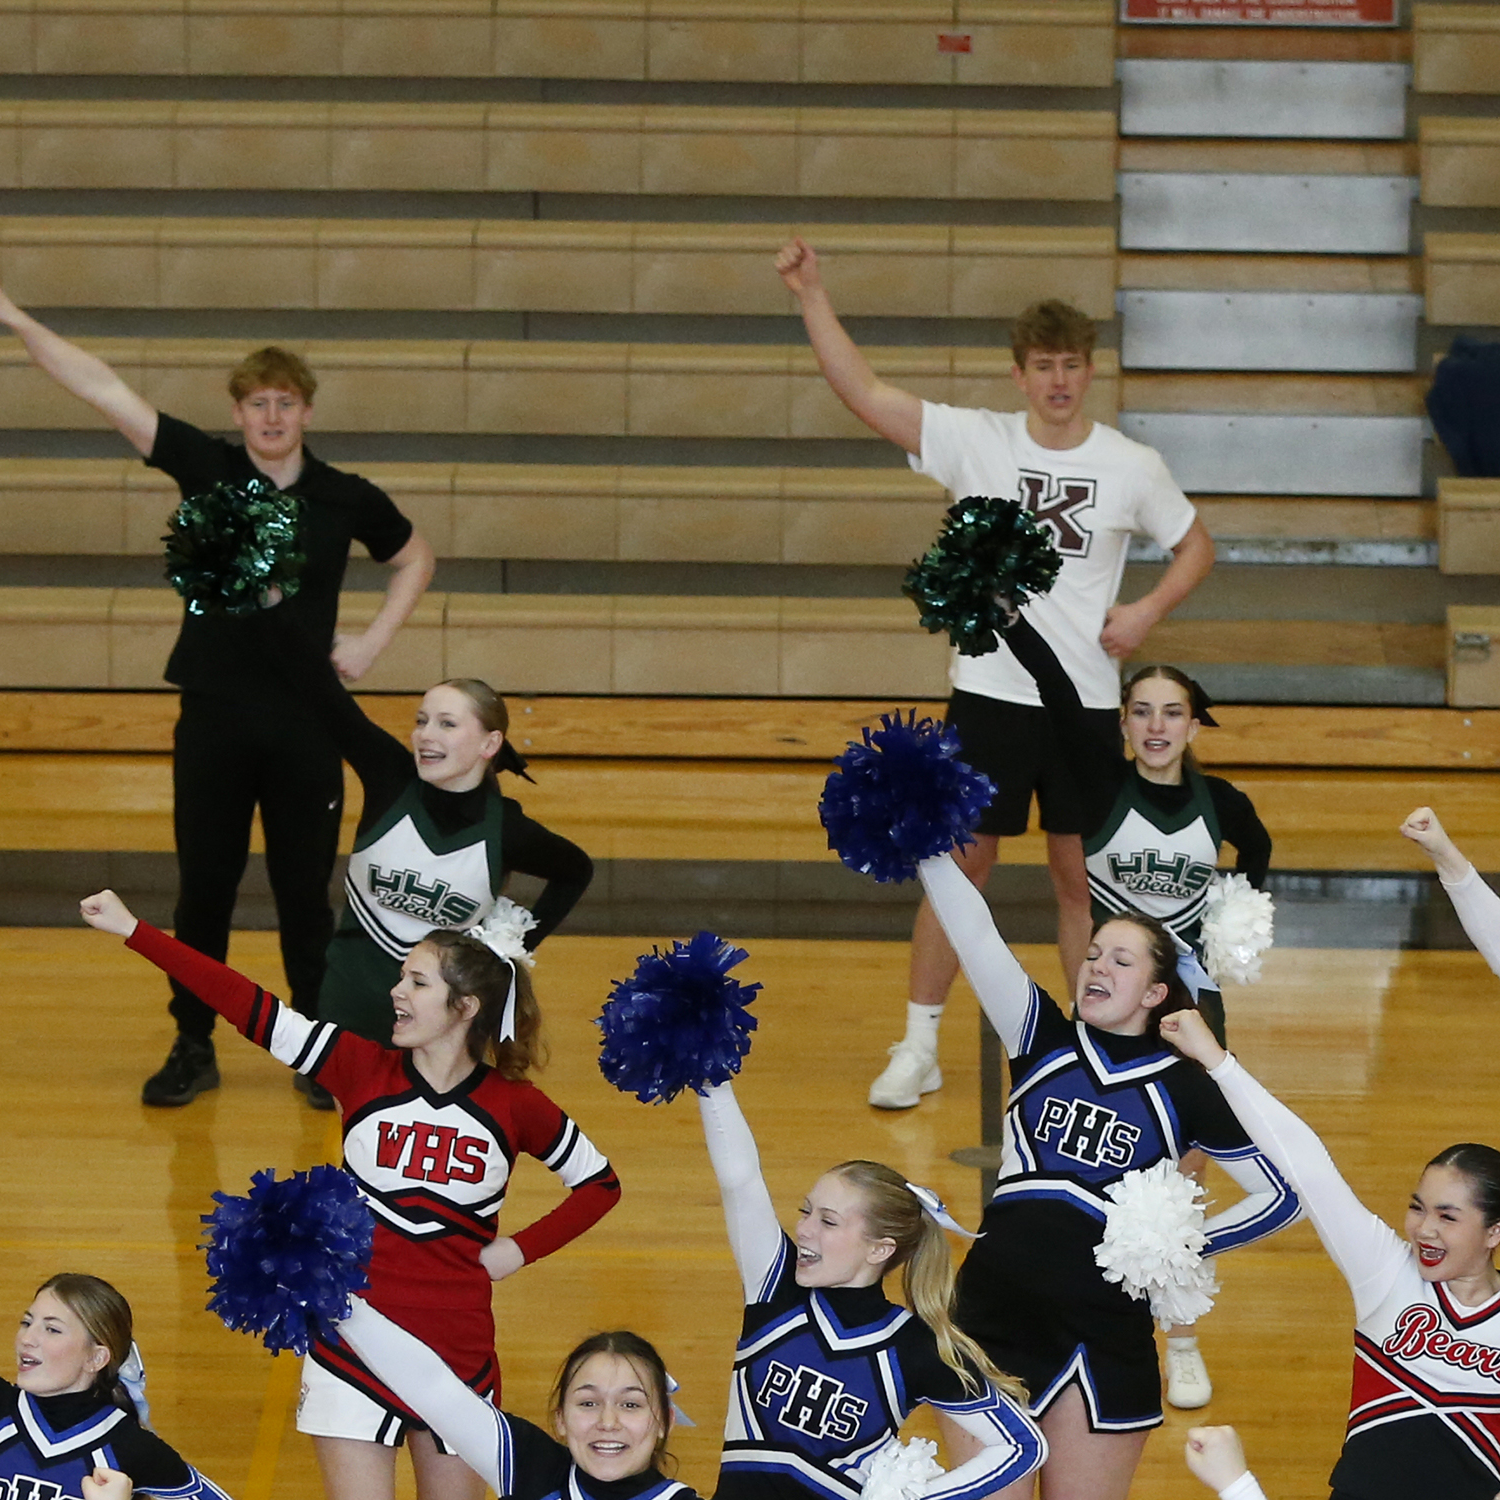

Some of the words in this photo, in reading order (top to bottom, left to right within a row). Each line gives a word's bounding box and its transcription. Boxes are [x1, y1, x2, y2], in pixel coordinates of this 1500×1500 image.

[1018, 468, 1097, 559] K
[368, 863, 481, 926] HHS
[1106, 848, 1217, 892] HHS
[1126, 872, 1197, 899] Bears
[377, 891, 452, 928] Bears
[376, 1120, 490, 1186] WHS
[1034, 1096, 1142, 1168] PHS
[756, 1359, 869, 1441] PHS
